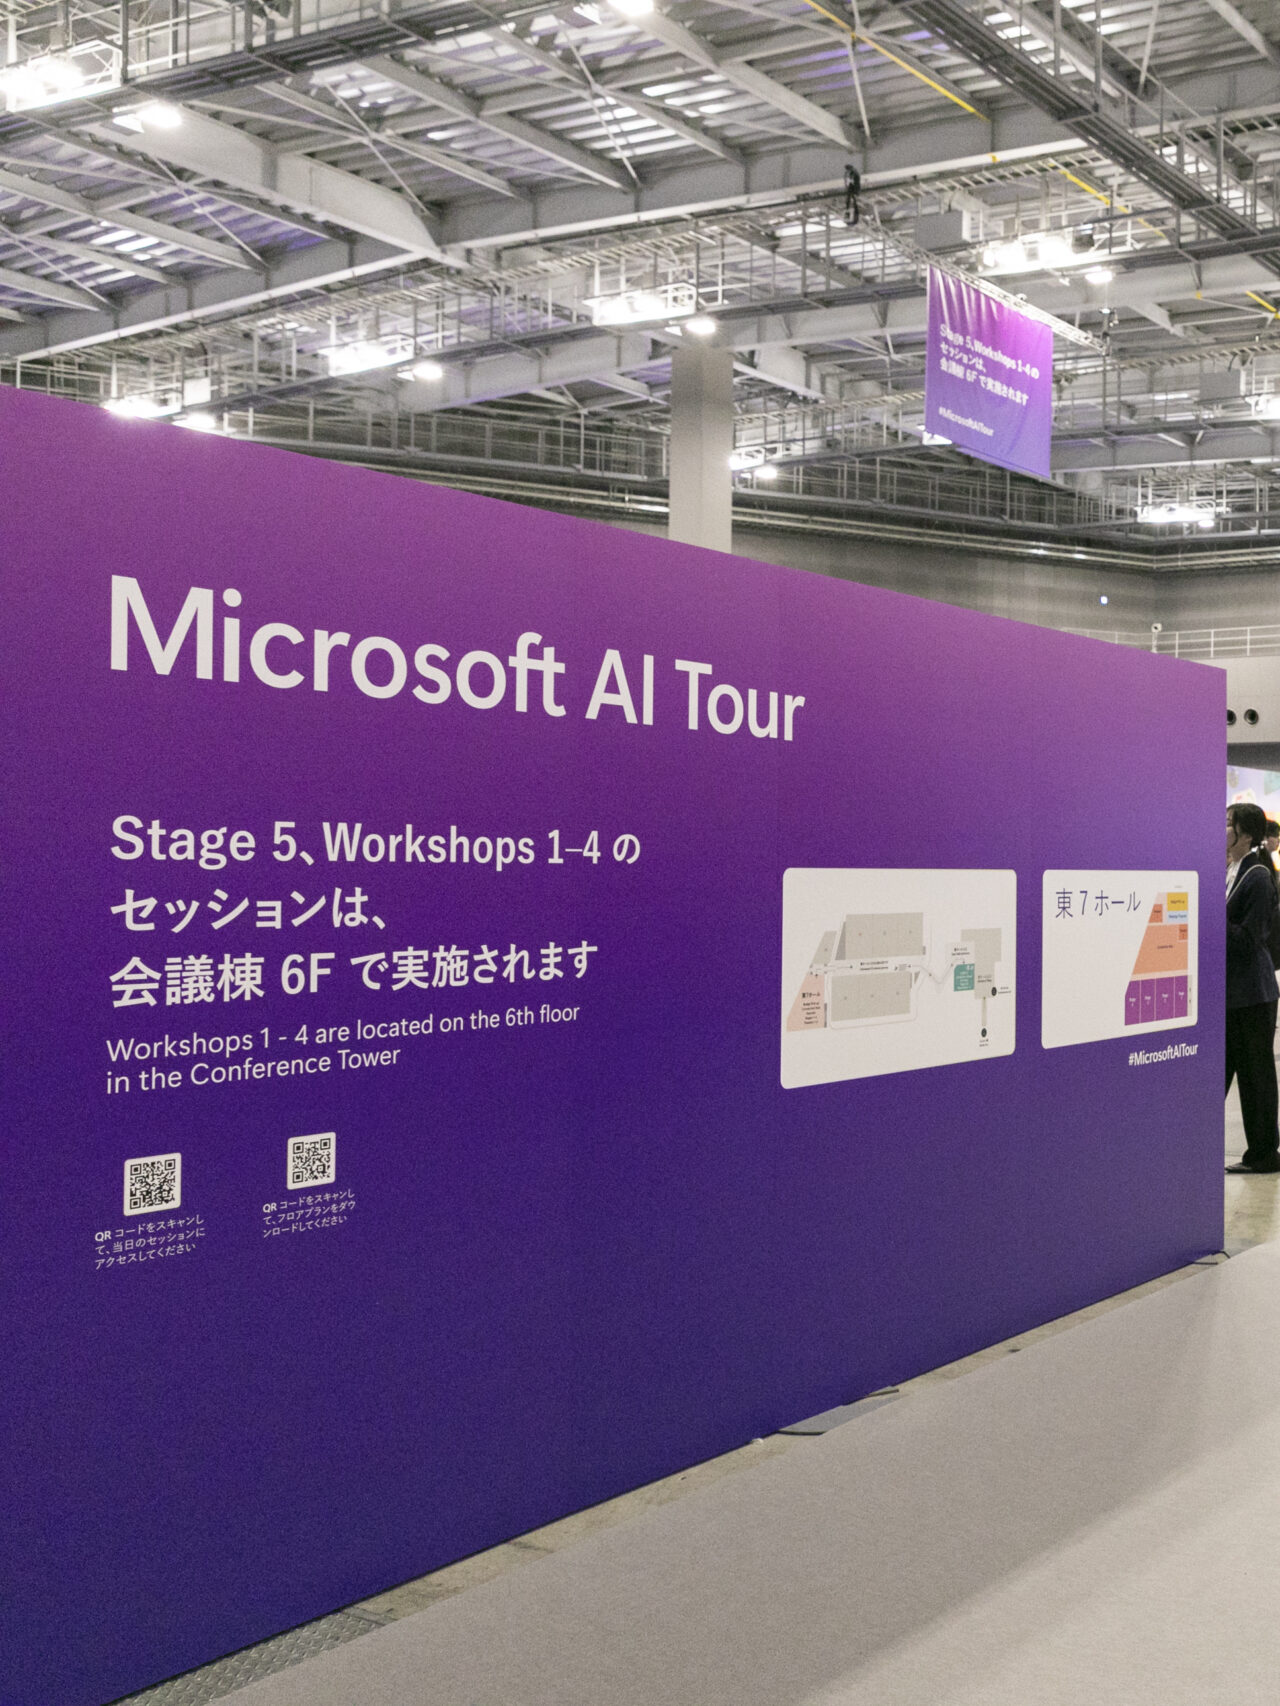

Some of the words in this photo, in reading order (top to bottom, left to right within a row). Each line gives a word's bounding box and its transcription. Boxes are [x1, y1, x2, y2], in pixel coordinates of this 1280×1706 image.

[110, 574, 567, 718] Microsoft
[584, 648, 655, 726] AI
[674, 658, 806, 742] Tour
[110, 814, 256, 871] Stage
[612, 833, 641, 865] の
[110, 886, 386, 934] セッションは、
[281, 952, 336, 995] 6F
[106, 1032, 253, 1062] Workshops
[260, 1027, 269, 1049] 1
[294, 1024, 309, 1045] 4
[315, 1027, 350, 1044] are
[357, 1013, 433, 1040] located
[439, 1016, 464, 1033] on
[469, 1009, 500, 1030] the
[505, 1006, 534, 1027] 6th
[539, 1004, 580, 1023] floor
[1128, 1043, 1198, 1067] #MicrosoftAITour
[106, 1071, 130, 1095] in
[138, 1066, 182, 1091] the
[190, 1057, 331, 1085] Conference
[337, 1048, 401, 1070] Tower
[95, 1243, 196, 1270] アクセスしてください
